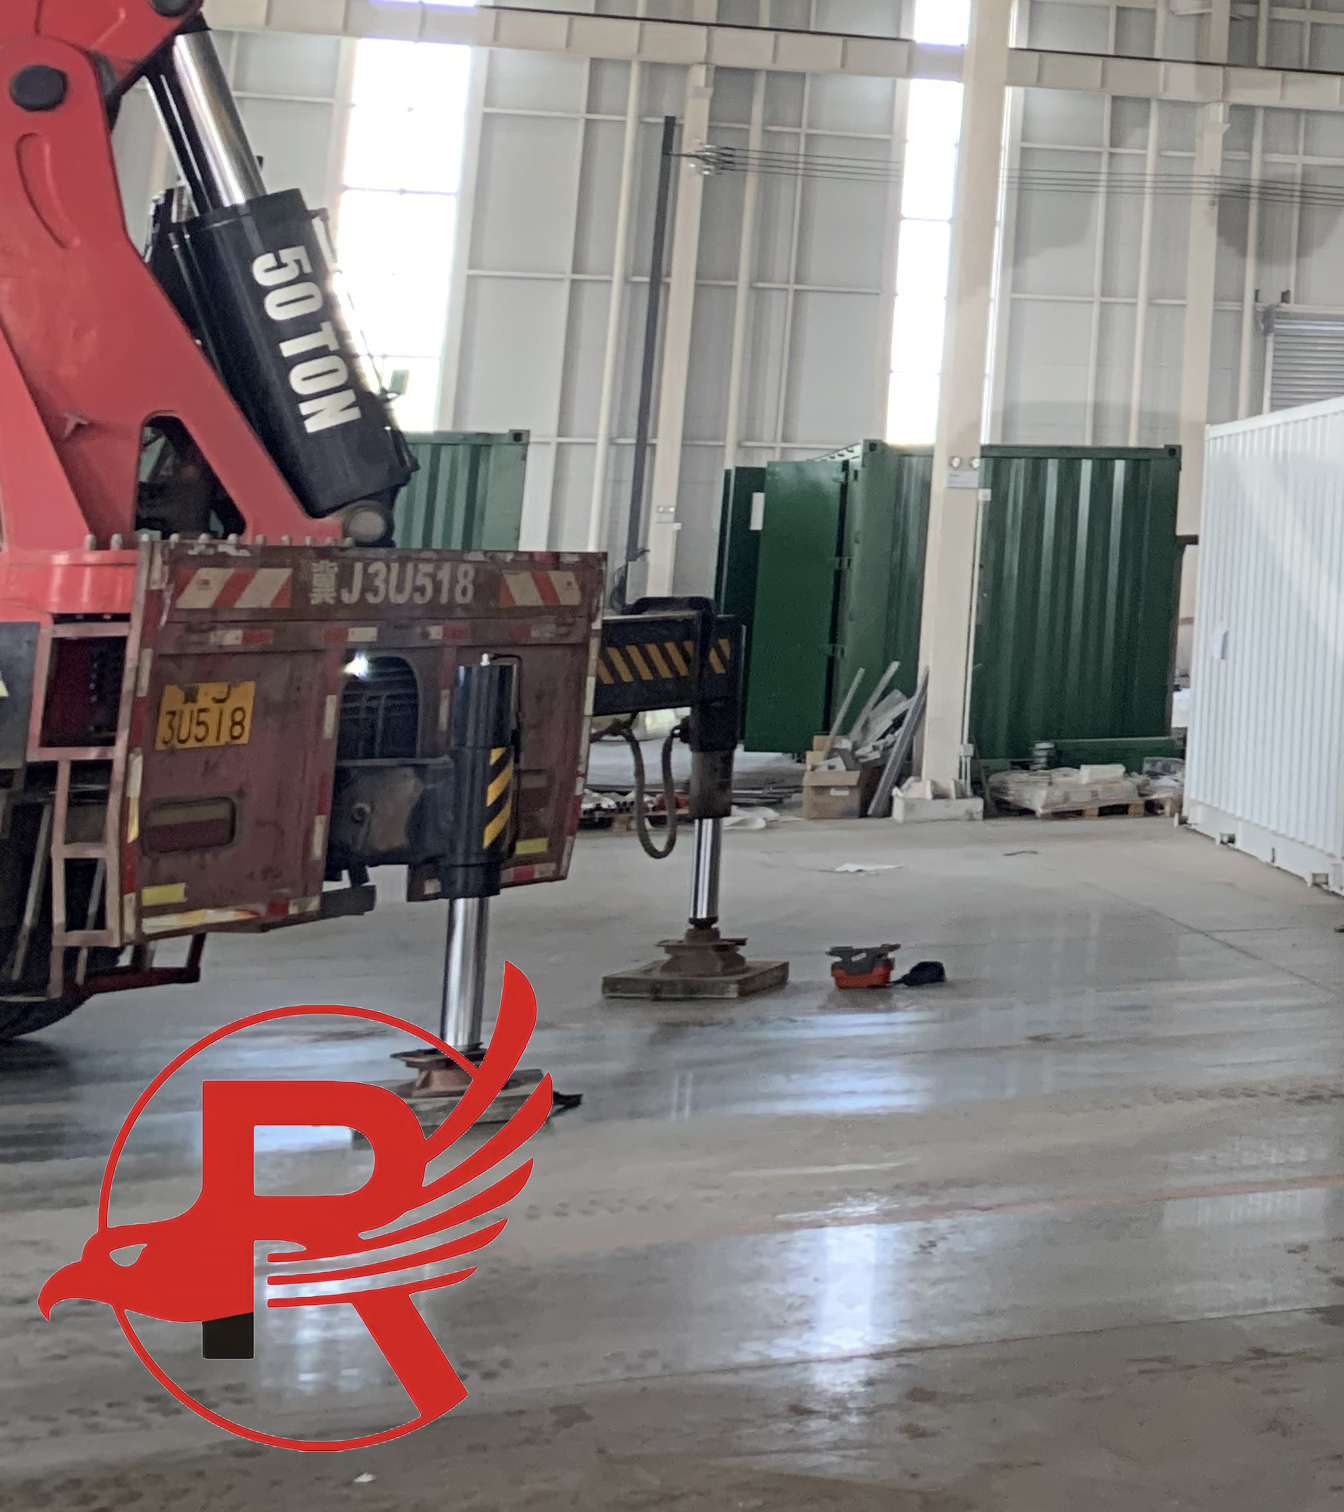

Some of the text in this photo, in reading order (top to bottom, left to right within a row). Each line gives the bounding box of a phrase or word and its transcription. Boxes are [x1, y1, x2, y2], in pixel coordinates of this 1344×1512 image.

[252, 245, 362, 433] 50 TON
[162, 706, 246, 745] 3U518
